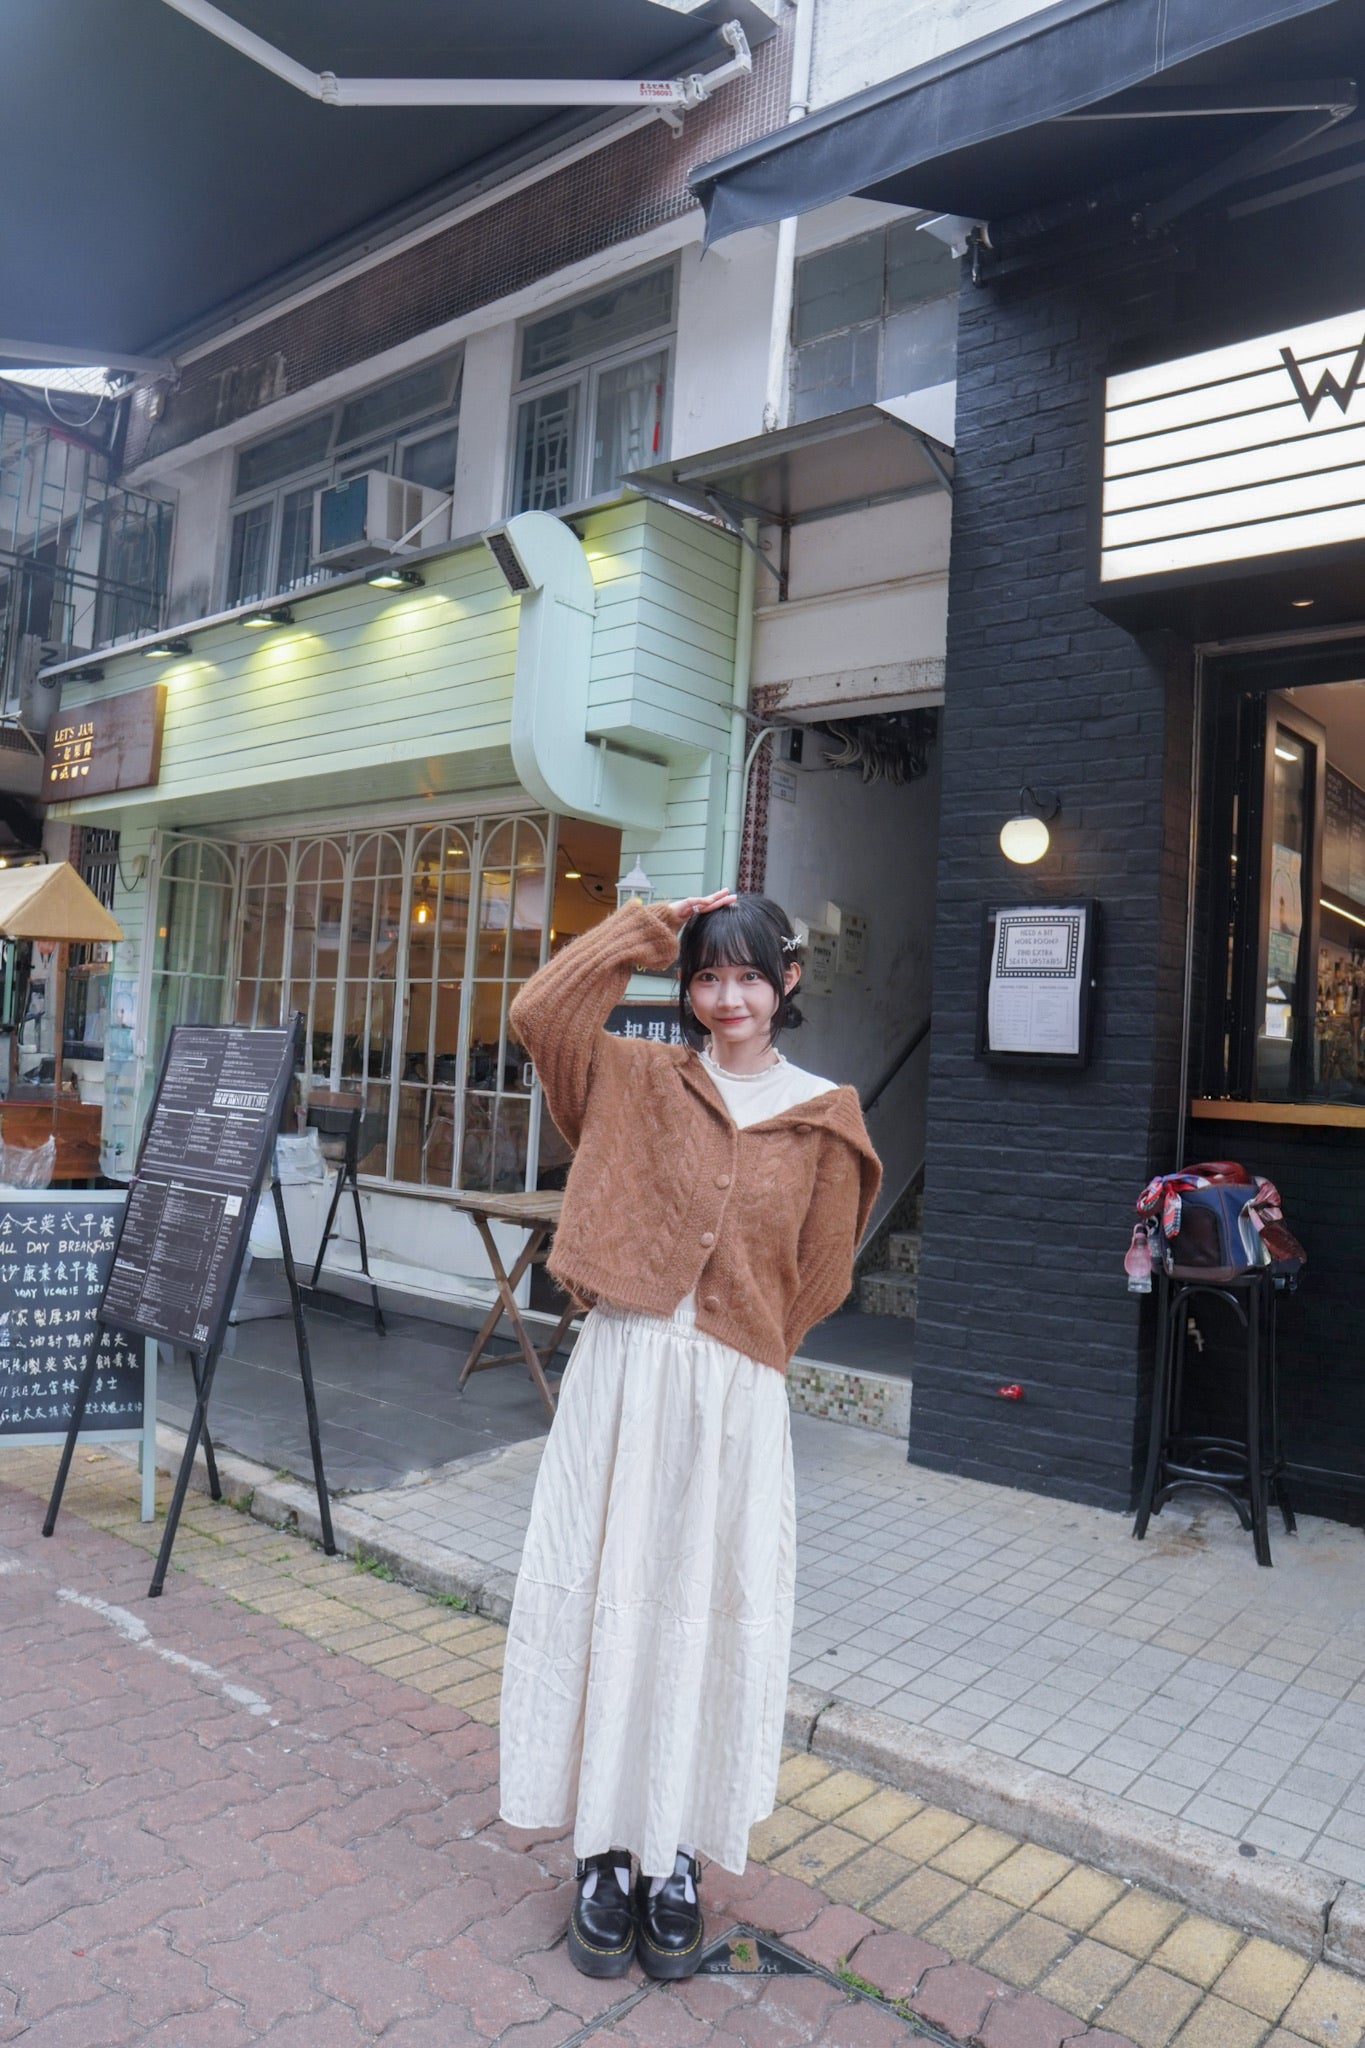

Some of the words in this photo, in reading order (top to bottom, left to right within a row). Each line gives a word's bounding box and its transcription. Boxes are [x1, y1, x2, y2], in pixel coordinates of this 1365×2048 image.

[78, 722, 94, 736] JAM
[1009, 957, 1028, 965] SEATS
[27, 1241, 50, 1254] DAY
[58, 1239, 115, 1256] BREAKFAST
